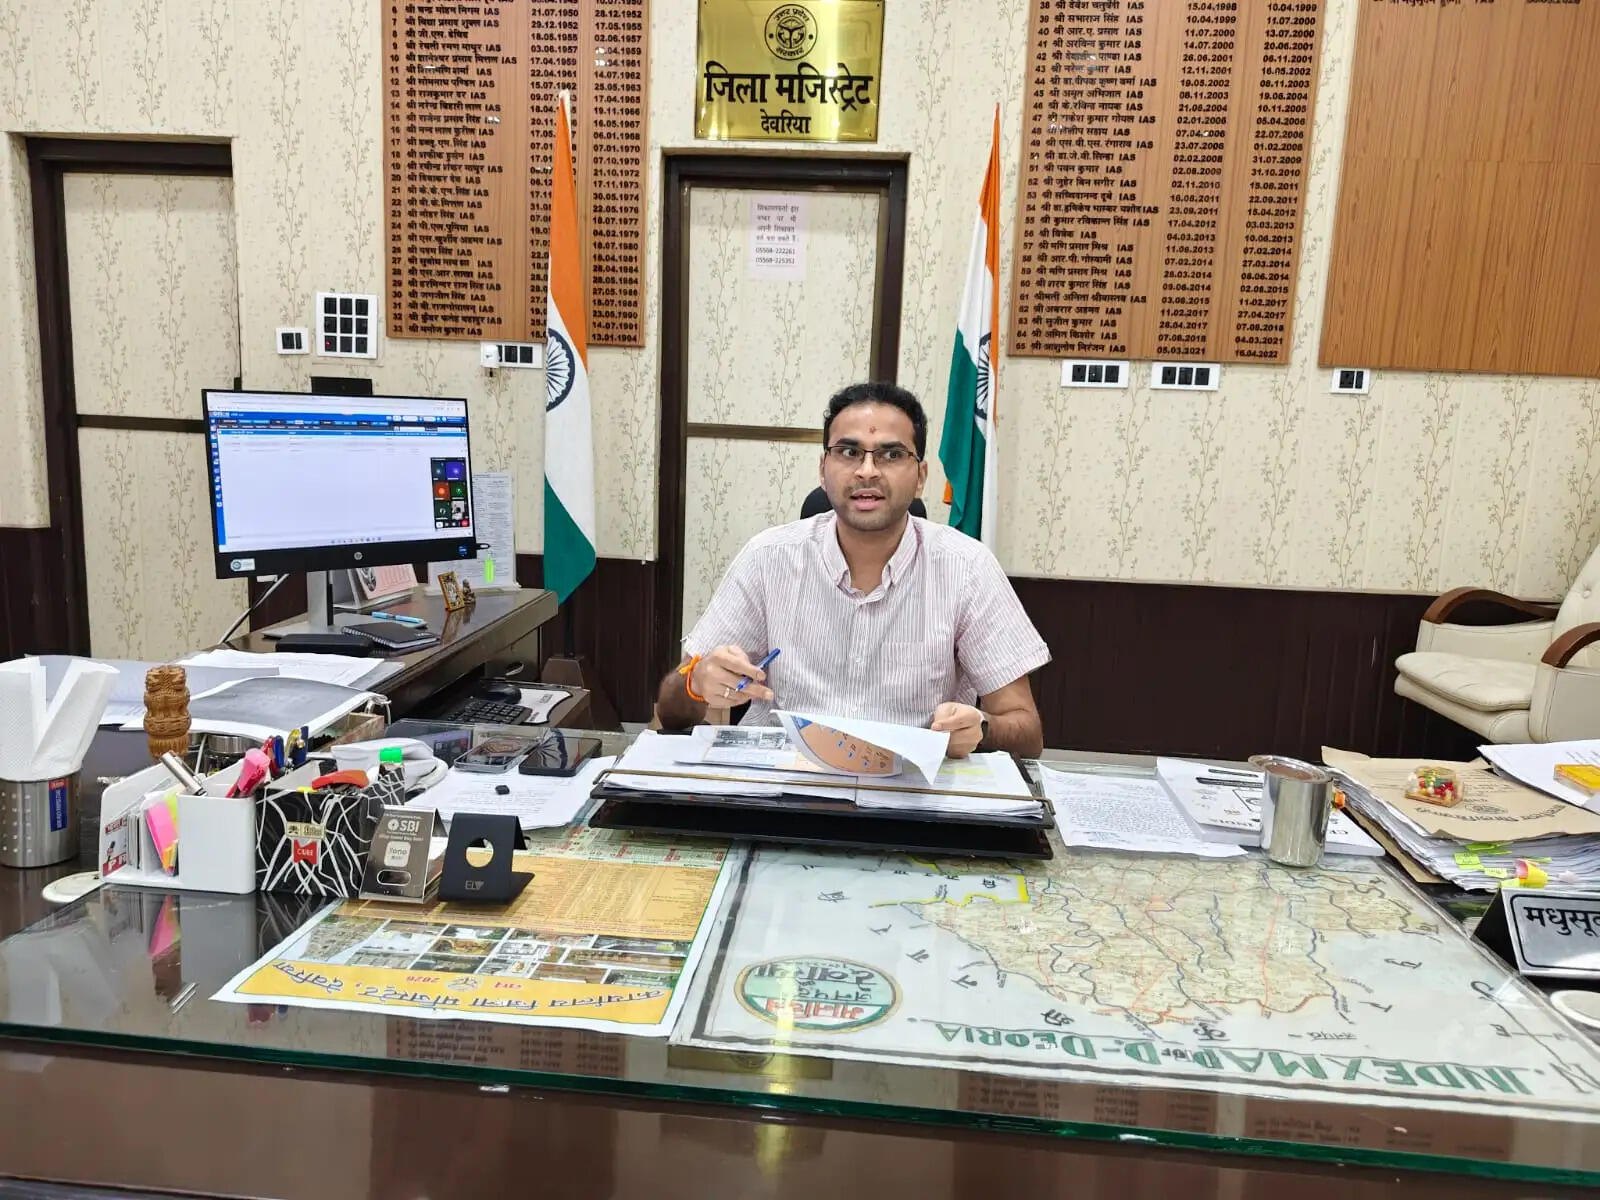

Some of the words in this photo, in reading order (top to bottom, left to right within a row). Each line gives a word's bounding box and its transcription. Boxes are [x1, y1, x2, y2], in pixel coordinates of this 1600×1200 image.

[1127, 1, 1144, 9] IAS
[484, 7, 499, 15] IAS
[483, 19, 499, 27] IAS
[1126, 15, 1142, 23] IAS
[1125, 27, 1141, 36] IAS
[1185, 28, 1235, 37] 11.07.2000
[1124, 40, 1140, 48] IAS
[501, 56, 516, 64] IAS
[1123, 52, 1141, 61] IAS
[1114, 65, 1131, 73] IAS
[479, 79, 494, 88] IAS
[704, 60, 770, 104] जिला
[775, 62, 873, 111] मजिस्ट्रेट
[1139, 78, 1156, 87] IAS
[1126, 90, 1143, 99] IAS
[1126, 102, 1142, 111] IAS
[761, 109, 811, 133] देवरिया
[1138, 115, 1155, 123] IAS
[1105, 165, 1122, 173] IAS
[1120, 179, 1136, 187] IAS
[1132, 218, 1149, 226] IAS
[1080, 231, 1096, 239] IAS
[1116, 256, 1132, 264] IAS
[1114, 281, 1130, 289] IAS
[1130, 295, 1146, 303] IAS
[1100, 319, 1116, 327] IAS
[1101, 332, 1116, 340] IAS
[1109, 344, 1125, 352] IAS
[400, 820, 420, 832] SBI
[272, 962, 344, 994] देवरिया
[549, 989, 664, 1009] कार्यालय
[468, 997, 538, 1010] जिला
